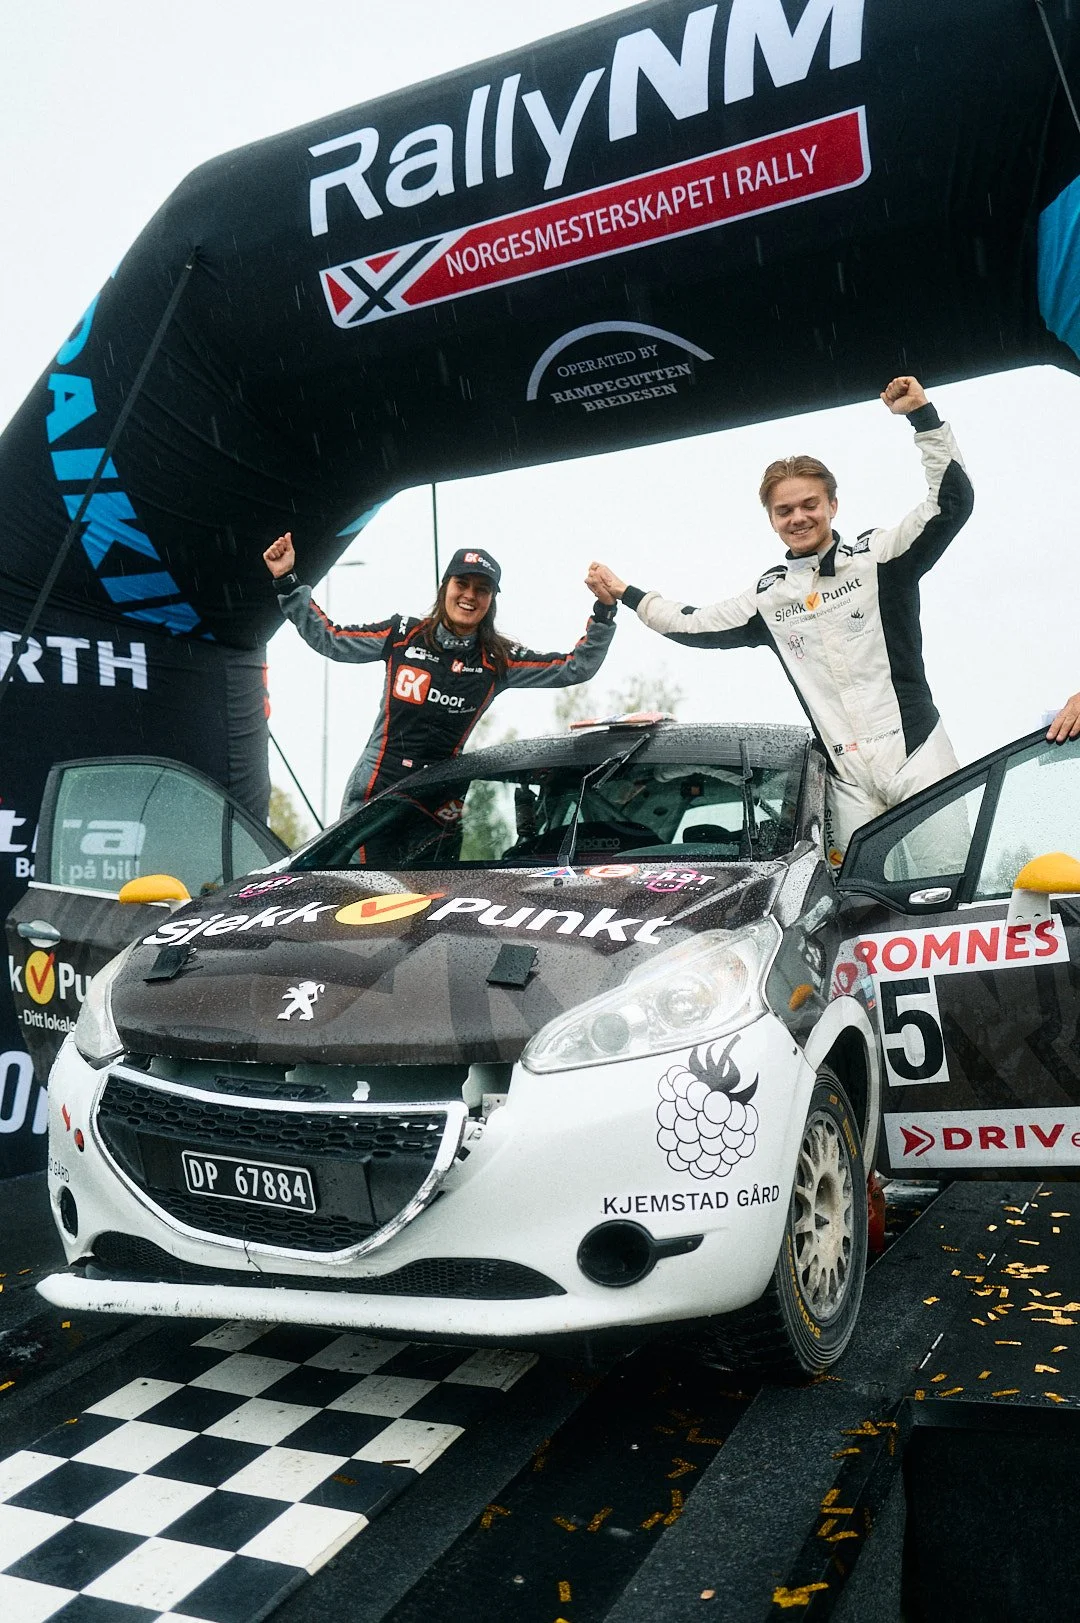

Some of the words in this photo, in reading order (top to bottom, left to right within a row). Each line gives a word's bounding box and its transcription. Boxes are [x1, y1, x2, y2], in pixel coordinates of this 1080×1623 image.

[445, 175, 716, 277] NORGESMESTERSKAPET
[722, 172, 731, 199] I
[736, 145, 818, 195] RALLY
[557, 351, 636, 378] OPERATED
[638, 345, 658, 359] BY
[551, 363, 692, 403] RAMPEGUTTEN
[582, 383, 678, 412] BREDESEN
[775, 603, 806, 622] Sjekk
[822, 578, 862, 603] Punkt
[396, 669, 428, 702] GK
[427, 687, 465, 708] Door
[70, 859, 97, 885] på
[142, 902, 339, 946] Sjekk
[426, 897, 675, 945] Punkt
[24, 1009, 43, 1028] Ditt
[880, 977, 944, 1080] 5
[942, 1124, 1064, 1151] DRIV
[189, 1159, 218, 1190] DP
[235, 1166, 307, 1205] 67884
[604, 1191, 729, 1215] KJEMSTAD
[736, 1183, 780, 1207] GÅRD
